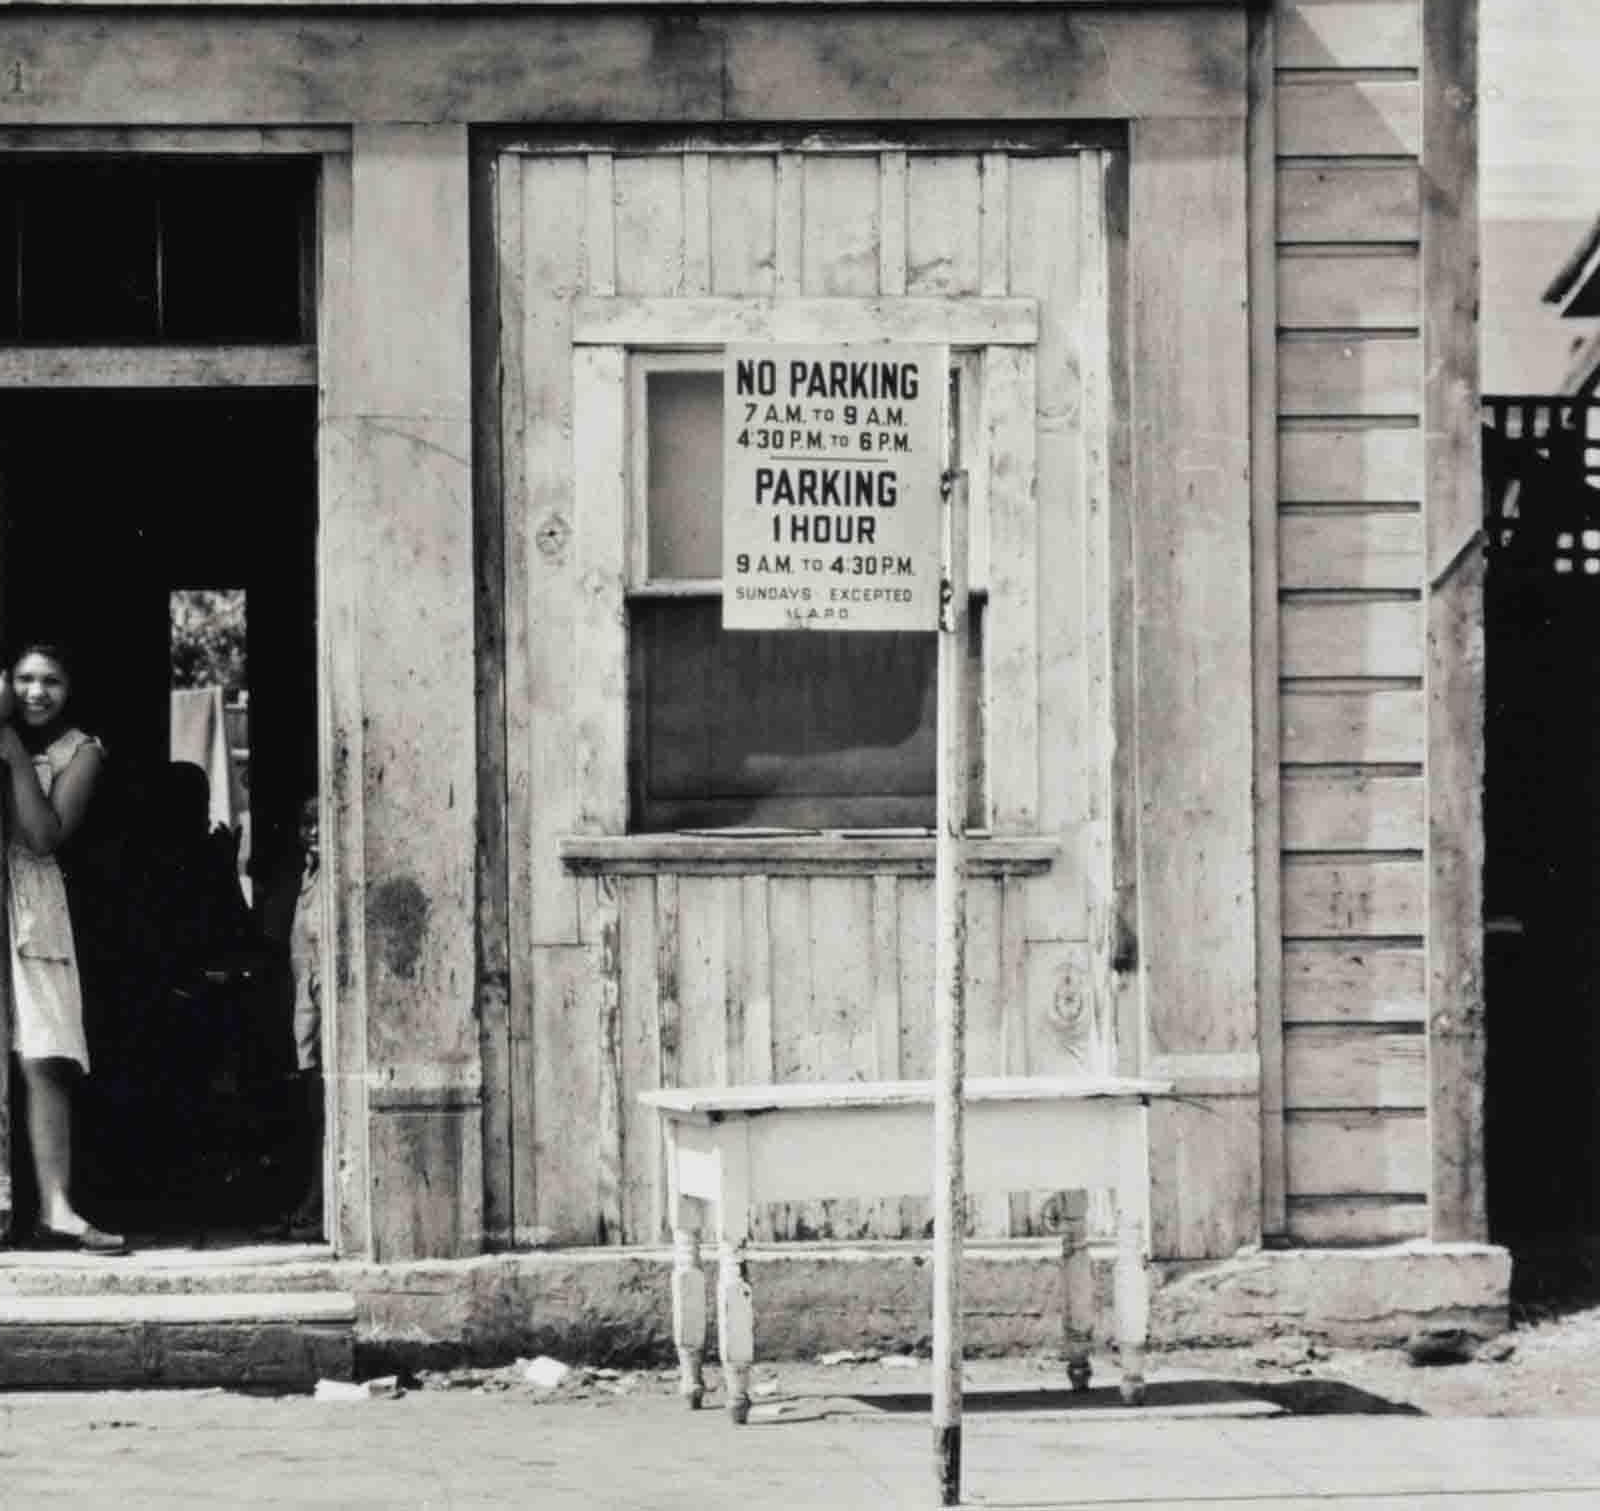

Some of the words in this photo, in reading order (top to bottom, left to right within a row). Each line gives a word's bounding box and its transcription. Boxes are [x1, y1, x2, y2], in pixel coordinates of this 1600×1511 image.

[736, 359, 777, 396] NO
[790, 361, 919, 400] PARKING
[744, 402, 758, 423] 7
[764, 403, 807, 424] A.M.
[812, 408, 834, 422] TO
[843, 405, 857, 425] 9
[866, 407, 908, 426] A.M.
[790, 430, 826, 450] P.M.
[831, 434, 849, 448] TO
[859, 431, 872, 451] 6
[878, 432, 912, 453] P.M.
[755, 468, 898, 508] PARKING
[772, 514, 781, 543] 1
[791, 514, 876, 544] HOUR
[736, 554, 750, 574] 9
[757, 555, 794, 575] A.M.
[803, 559, 823, 572] TO
[882, 556, 915, 577] P.M.
[735, 587, 812, 602] SUNDAYS
[830, 588, 913, 603] EXCEPTED
